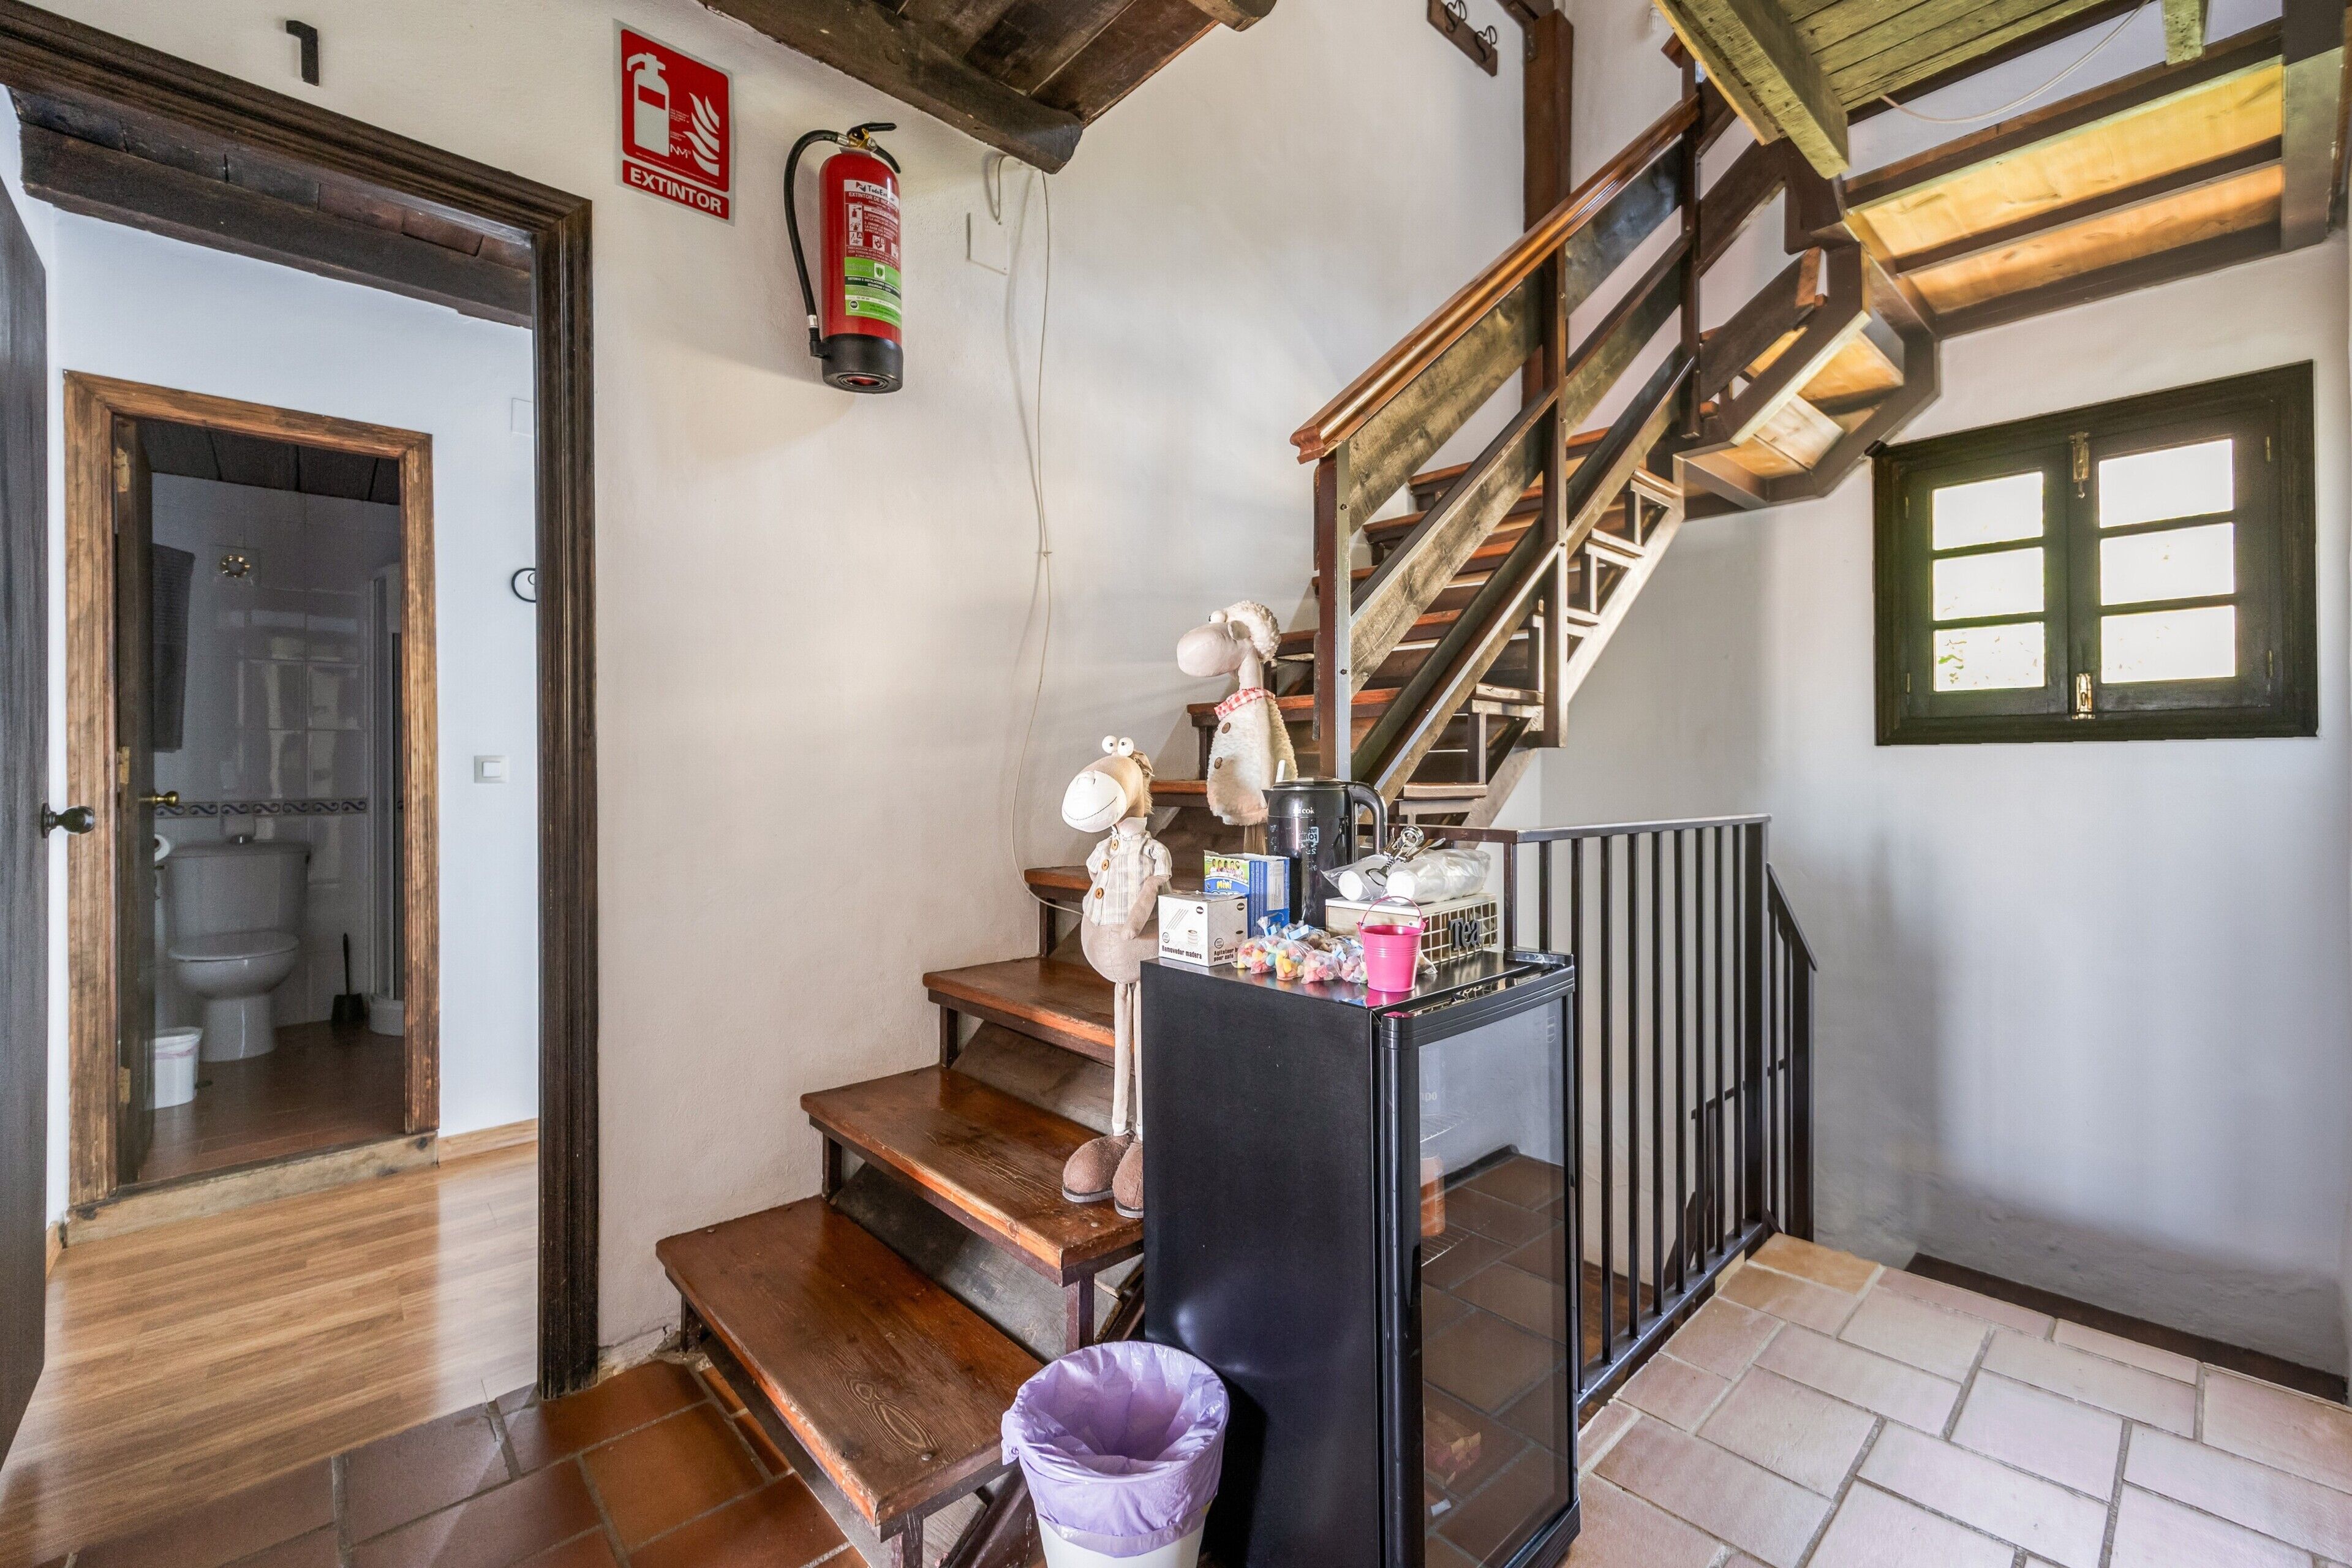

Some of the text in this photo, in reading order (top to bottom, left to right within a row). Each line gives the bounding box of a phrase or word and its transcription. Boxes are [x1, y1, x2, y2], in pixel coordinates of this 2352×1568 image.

[630, 166, 722, 214] EXTINTOR
[848, 192, 873, 200] EXTINTOR
[1449, 918, 1481, 951] Tea
[1162, 945, 1202, 959] Removedor madera
[1213, 948, 1234, 957] Agitateur
